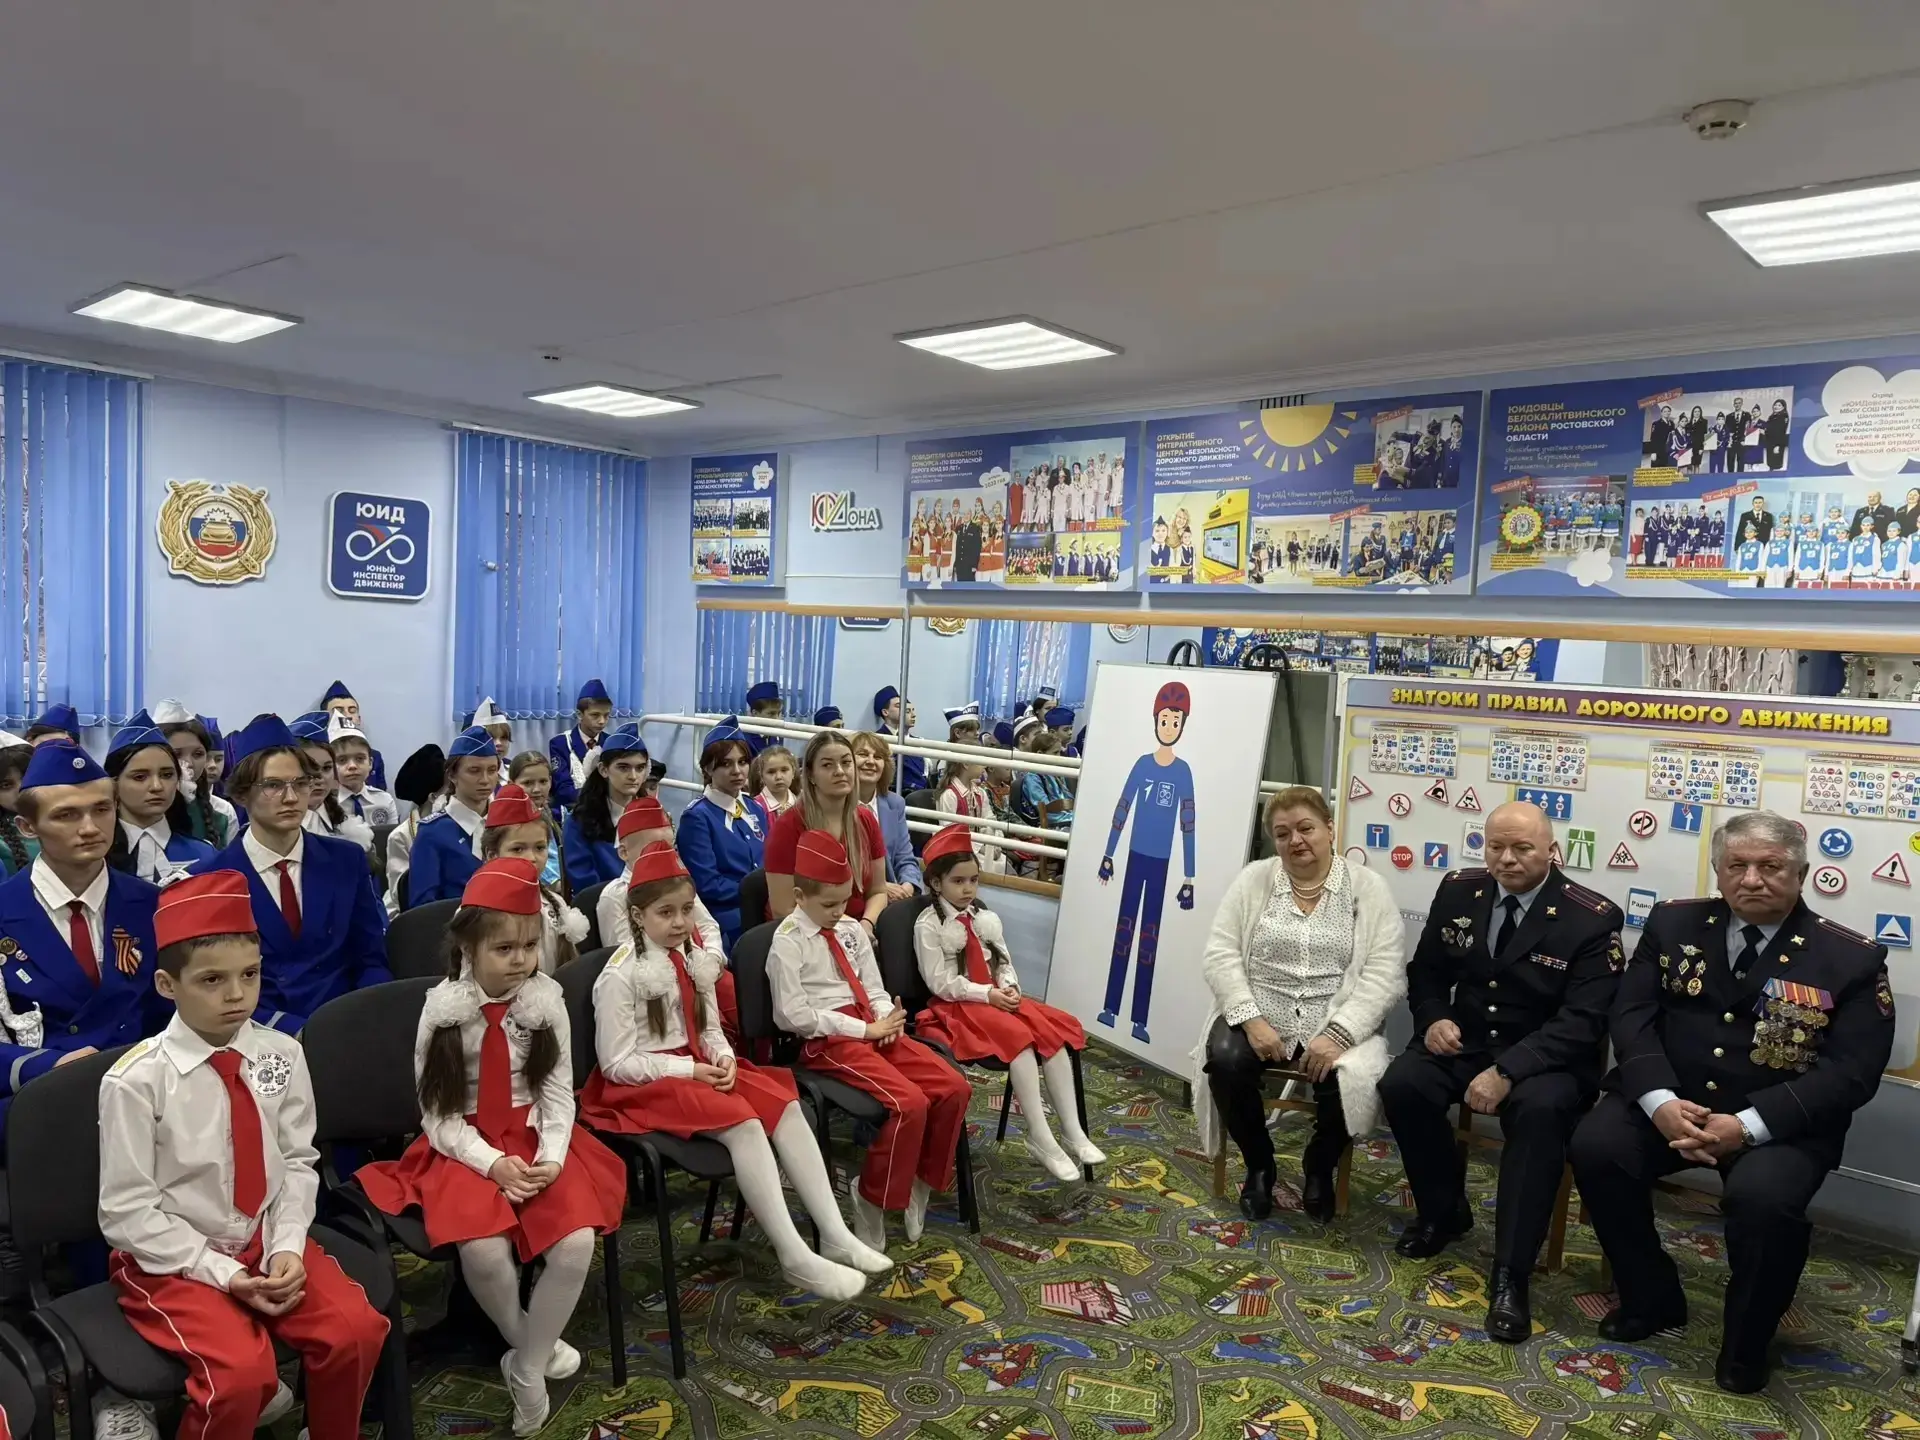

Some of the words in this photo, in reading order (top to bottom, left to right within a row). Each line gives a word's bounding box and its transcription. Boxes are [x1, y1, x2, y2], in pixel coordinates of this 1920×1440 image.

[1508, 402, 1564, 413] ЮИДОВЦЫ
[1507, 408, 1626, 423] БЕЛОКАЛИТВИНСКОГО
[1507, 422, 1549, 432] РАЙОНА
[1550, 418, 1614, 430] РОСТОВСКОЙ
[1157, 432, 1195, 441] ОТКРЫТИЕ
[1506, 432, 1549, 442] ОБЛАСТИ
[1156, 438, 1222, 449] ИНТЕРАКТИВНОГО
[947, 449, 983, 457] ОБЛАСТНОГО
[1156, 449, 1184, 458] ЦЕНТРА
[1185, 445, 1240, 455] «БЕЗОПАСНОСТЬ
[1156, 455, 1197, 465] ДОРОЖНОГО
[1198, 453, 1239, 462] ДВИЖЕНИЯ»
[356, 502, 405, 524] ЮИД
[366, 564, 396, 573] ЮНЫЙ
[353, 571, 405, 582] ИНСПЕКТОР
[354, 579, 404, 589] ДВИЖЕНИЯ
[1390, 688, 1478, 707] ЗНАТОКИ
[1487, 694, 1568, 713] ПРАВИЛ
[1576, 699, 1730, 724] ДОРОЖНОГО
[1738, 708, 1889, 734] ДВИЖЕНИЯ
[1392, 853, 1412, 861] STOP
[1818, 872, 1839, 888] 50
[1631, 900, 1652, 909] Радио
